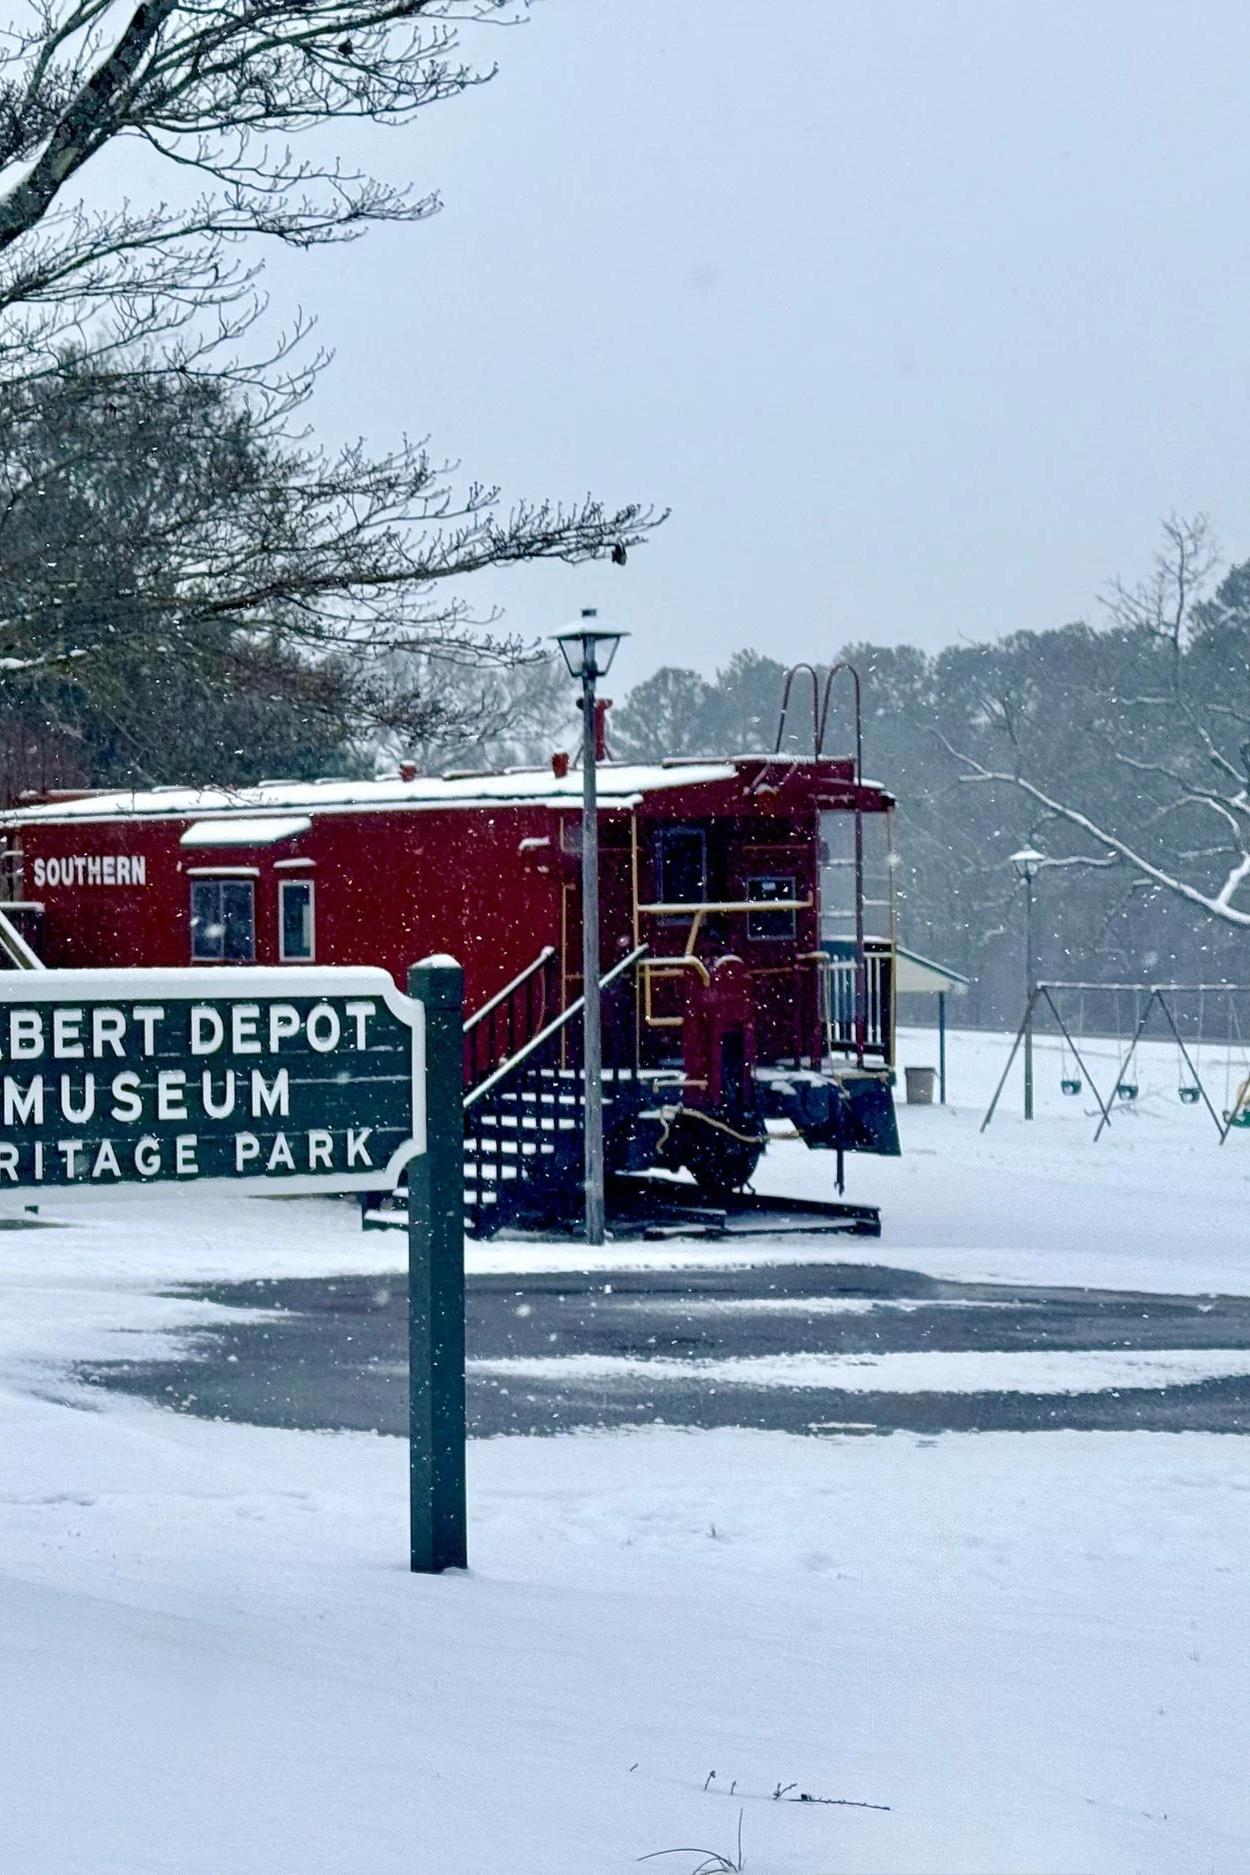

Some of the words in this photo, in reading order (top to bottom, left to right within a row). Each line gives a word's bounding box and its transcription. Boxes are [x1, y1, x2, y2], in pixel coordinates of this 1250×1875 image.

[33, 855, 146, 886] SOUTHERN
[191, 1003, 376, 1055] DEPOT
[3, 1068, 290, 1125] MUSEUM
[235, 1129, 373, 1172] PARK
